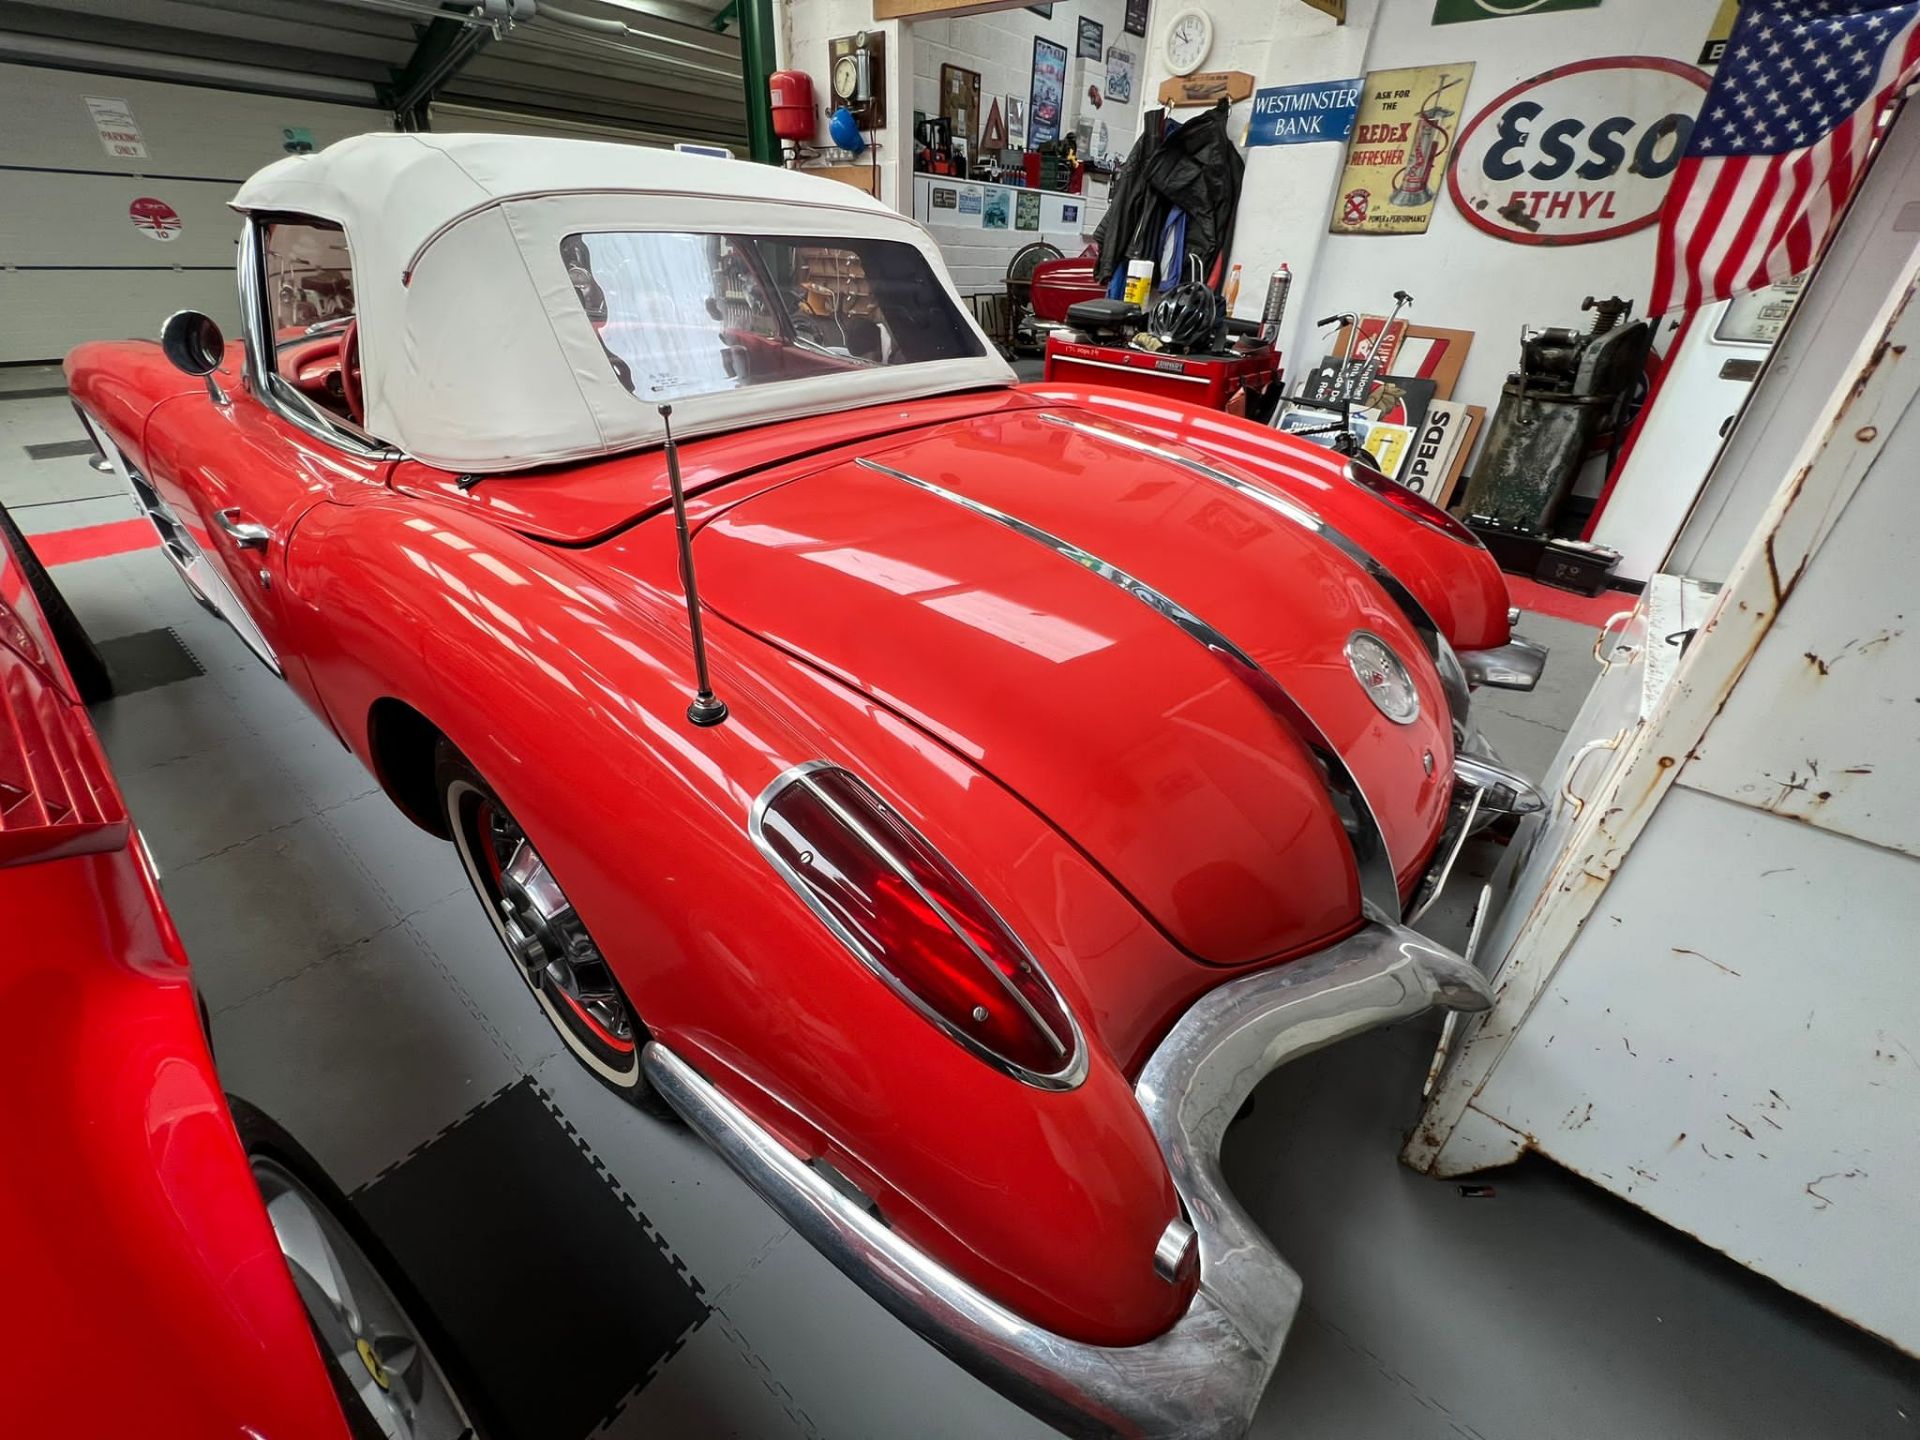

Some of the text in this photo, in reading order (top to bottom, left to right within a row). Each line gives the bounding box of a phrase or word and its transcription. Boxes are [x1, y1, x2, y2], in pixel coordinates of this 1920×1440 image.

[1256, 88, 1358, 114] WESTMINSTER
[1375, 89, 1411, 100] ASK FOR
[1382, 101, 1398, 111] THE
[1275, 115, 1323, 136] BANK
[101, 131, 139, 143] PARKING
[1482, 101, 1695, 181] ESSO
[1350, 149, 1405, 166] REFRESHER
[1390, 214, 1427, 223] PERFORMANCE
[1406, 411, 1451, 494] OPEDS
